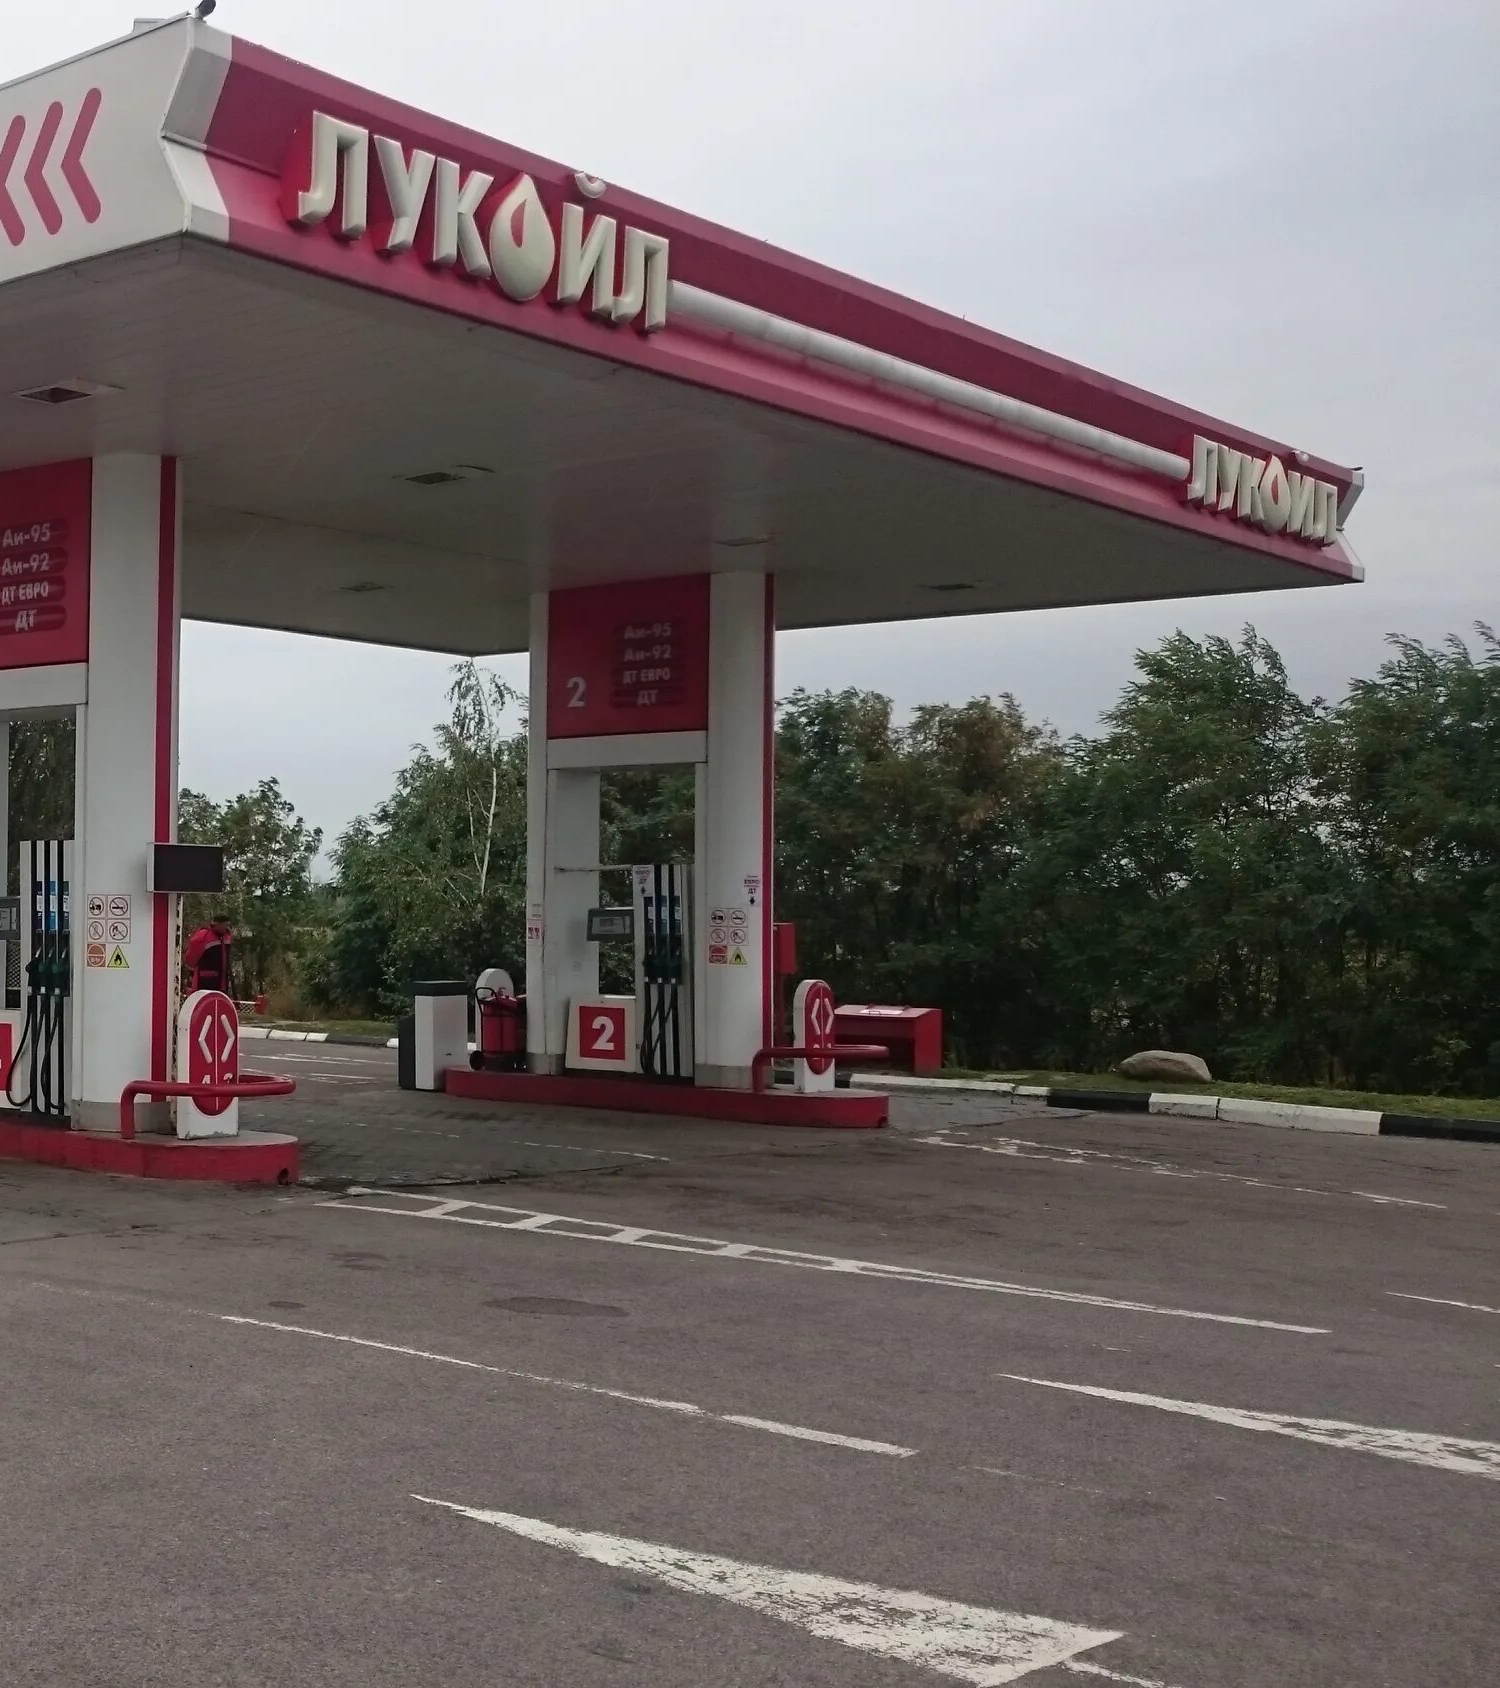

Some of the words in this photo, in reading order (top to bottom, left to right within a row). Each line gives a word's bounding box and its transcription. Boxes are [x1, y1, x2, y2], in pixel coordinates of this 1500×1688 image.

[298, 110, 669, 331] ЛУКОЙЛ
[1187, 434, 1338, 544] ЛУКОЙЛ
[1, 522, 51, 548] Аи-95
[1, 552, 50, 577] Аи-92
[1, 585, 16, 605] ДТ
[17, 581, 49, 600] ЕВРО
[15, 609, 38, 632] ДТ
[566, 676, 587, 708] 2
[591, 1016, 615, 1051] 2
